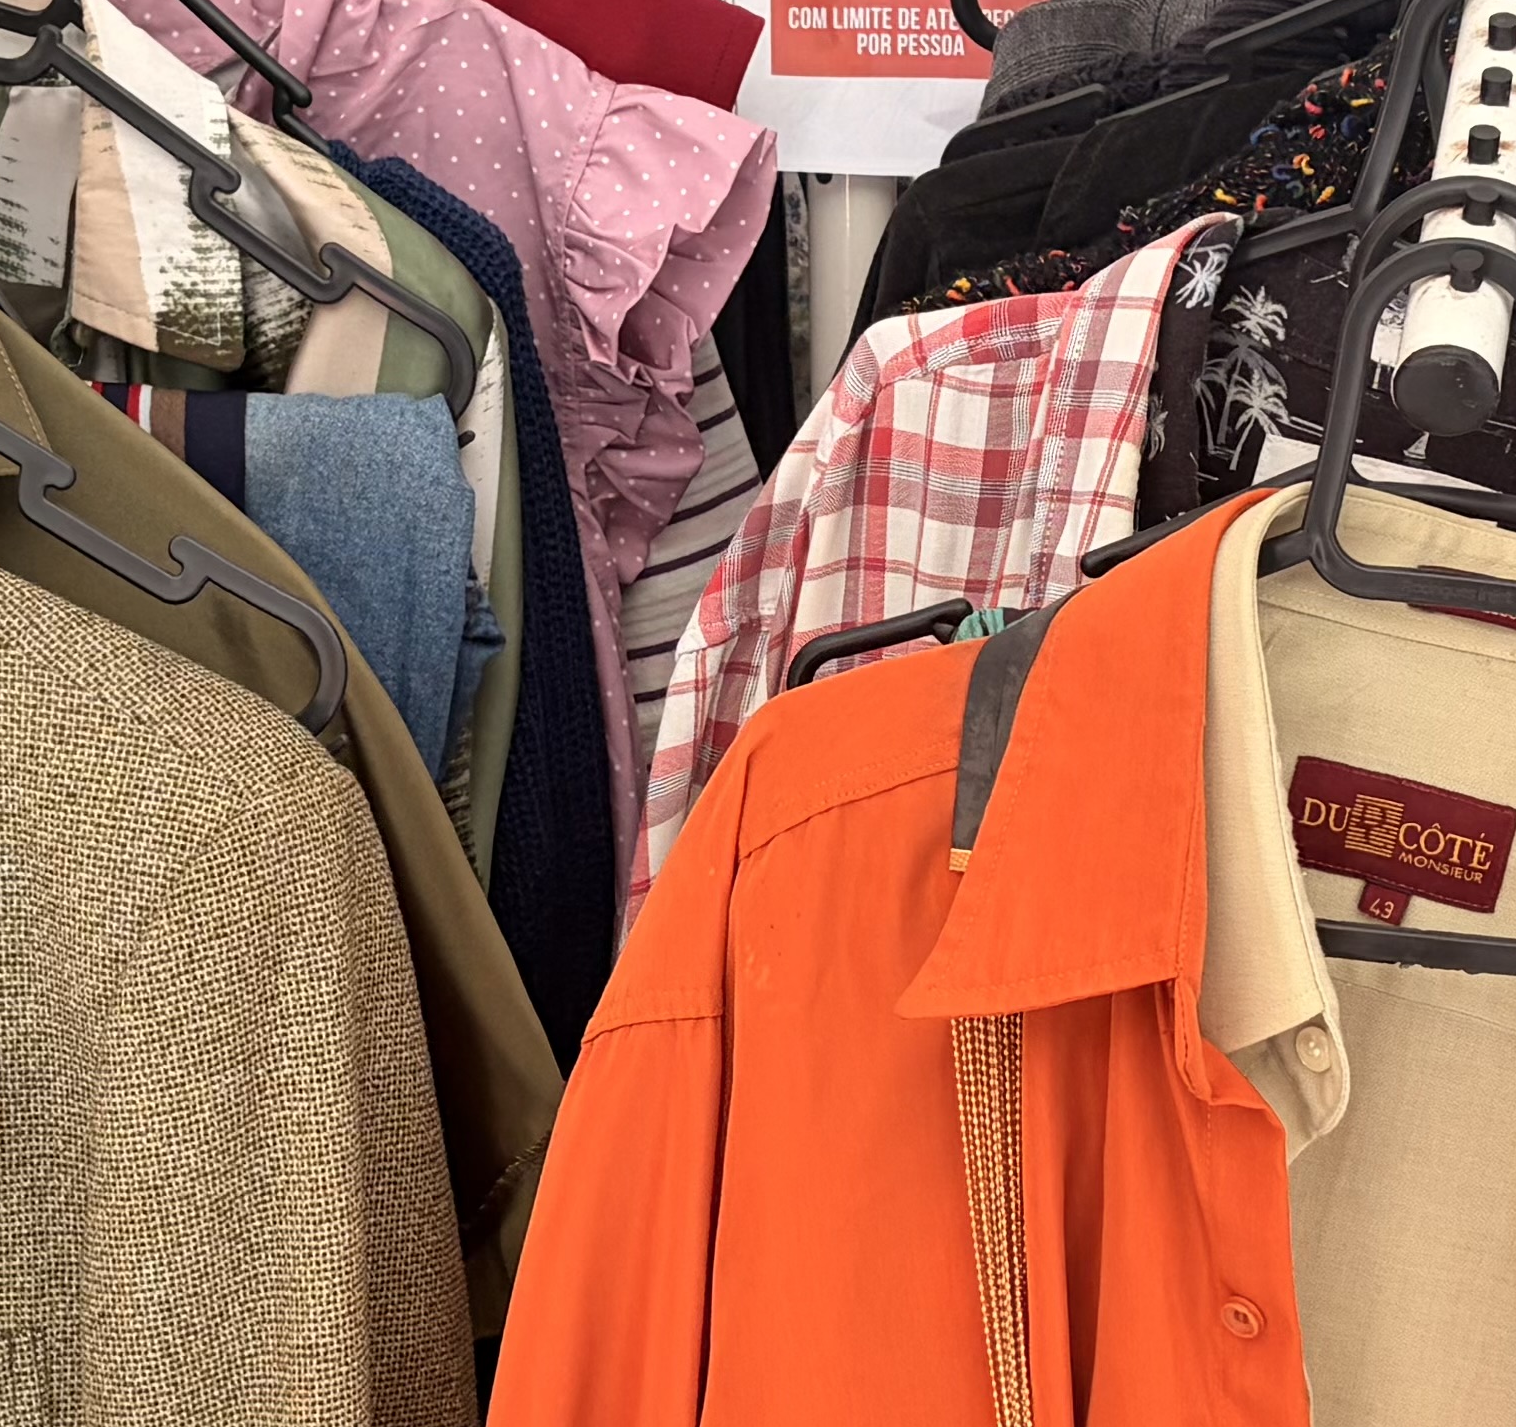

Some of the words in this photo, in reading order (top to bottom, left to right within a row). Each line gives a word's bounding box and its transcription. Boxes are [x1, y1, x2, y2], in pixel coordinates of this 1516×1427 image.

[788, 6, 828, 29] COM
[832, 6, 886, 30] LIMITE
[897, 7, 921, 30] DE
[856, 33, 892, 55] POR
[897, 34, 965, 57] PESSOA
[1299, 796, 1352, 832] DU
[1398, 822, 1495, 871] CÔTÉ
[1398, 851, 1484, 885] MONSIEUR
[1368, 897, 1395, 919] 43
